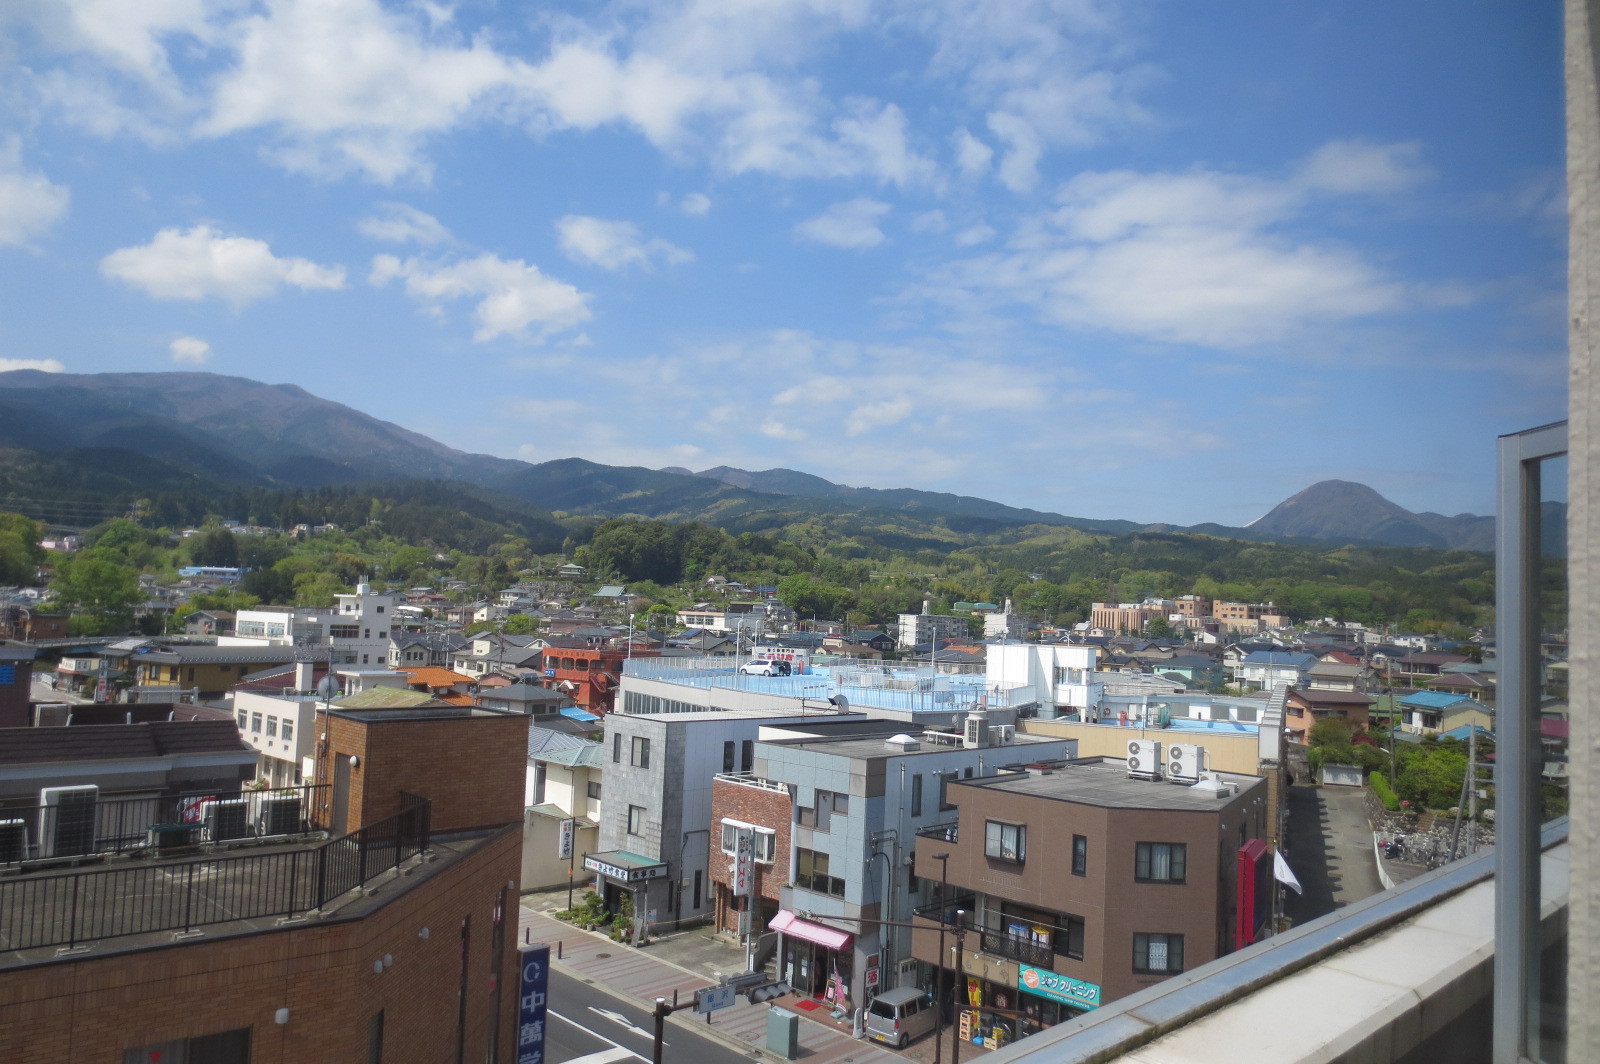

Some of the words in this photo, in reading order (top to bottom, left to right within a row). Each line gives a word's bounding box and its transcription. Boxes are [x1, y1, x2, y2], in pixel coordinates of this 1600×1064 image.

[867, 969, 878, 985] 酒
[1060, 979, 1097, 1001] クリーニング
